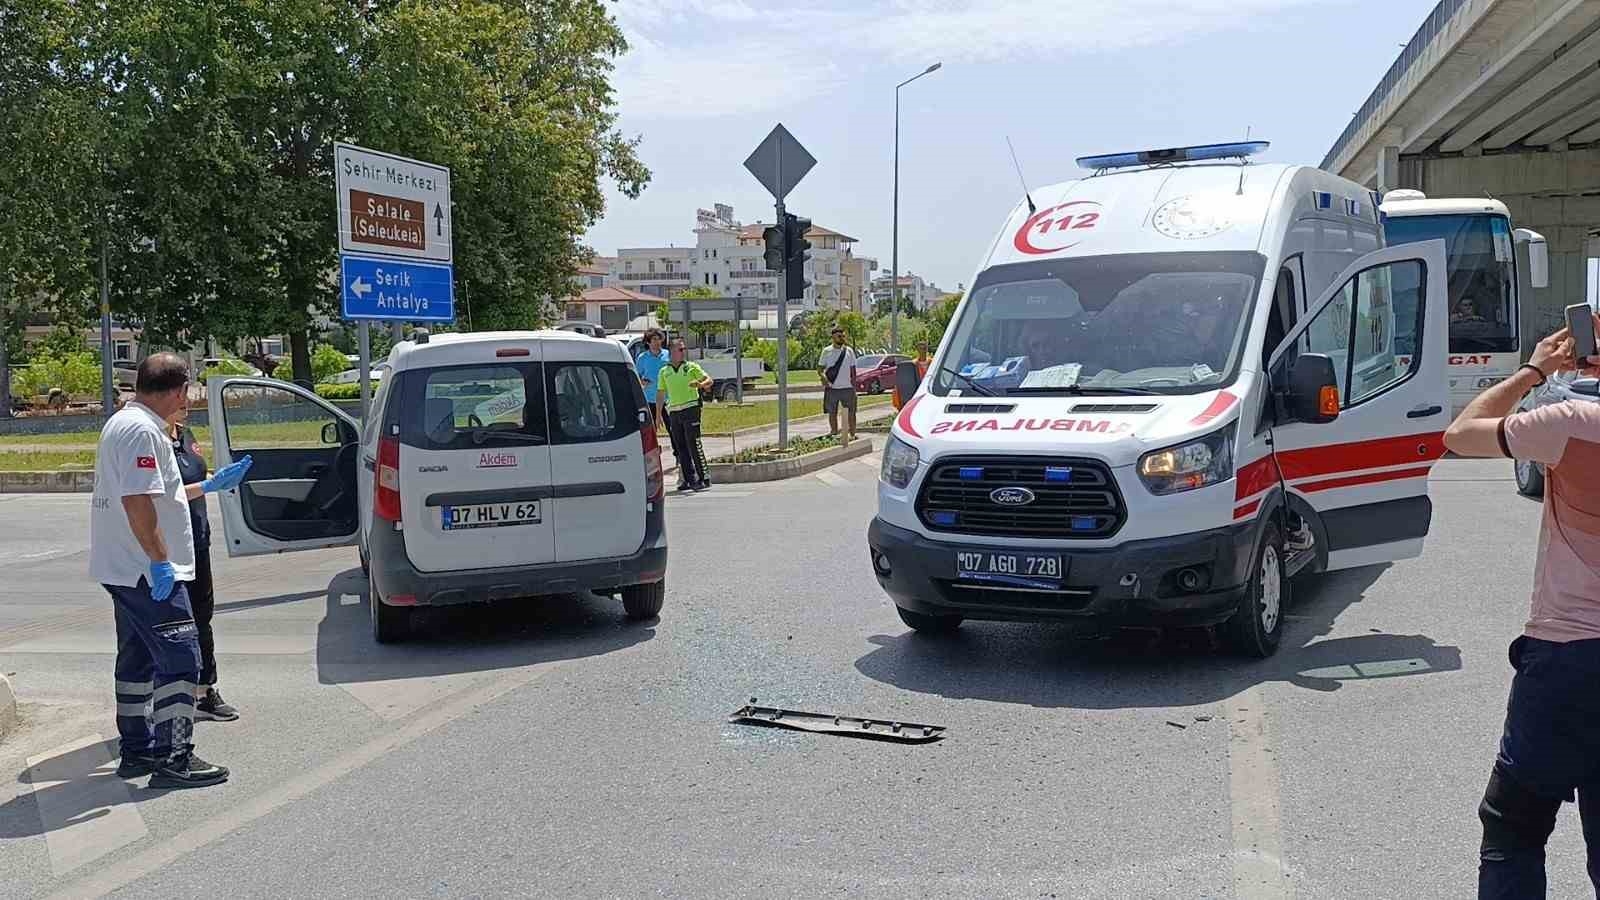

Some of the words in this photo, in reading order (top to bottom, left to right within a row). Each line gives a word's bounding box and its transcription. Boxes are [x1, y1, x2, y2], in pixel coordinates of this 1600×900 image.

[344, 158, 382, 181] Şehir
[386, 167, 437, 192] Merkezi
[354, 215, 422, 246] (Seleukeia)
[1036, 213, 1099, 234] 112
[376, 268, 411, 287] Serik
[377, 292, 429, 313] Antalya
[480, 453, 517, 465] Akdem
[452, 508, 471, 523] 07
[478, 505, 510, 522] HLV
[516, 503, 537, 519] 62
[964, 552, 982, 571] 07
[1026, 557, 1057, 575] 728
